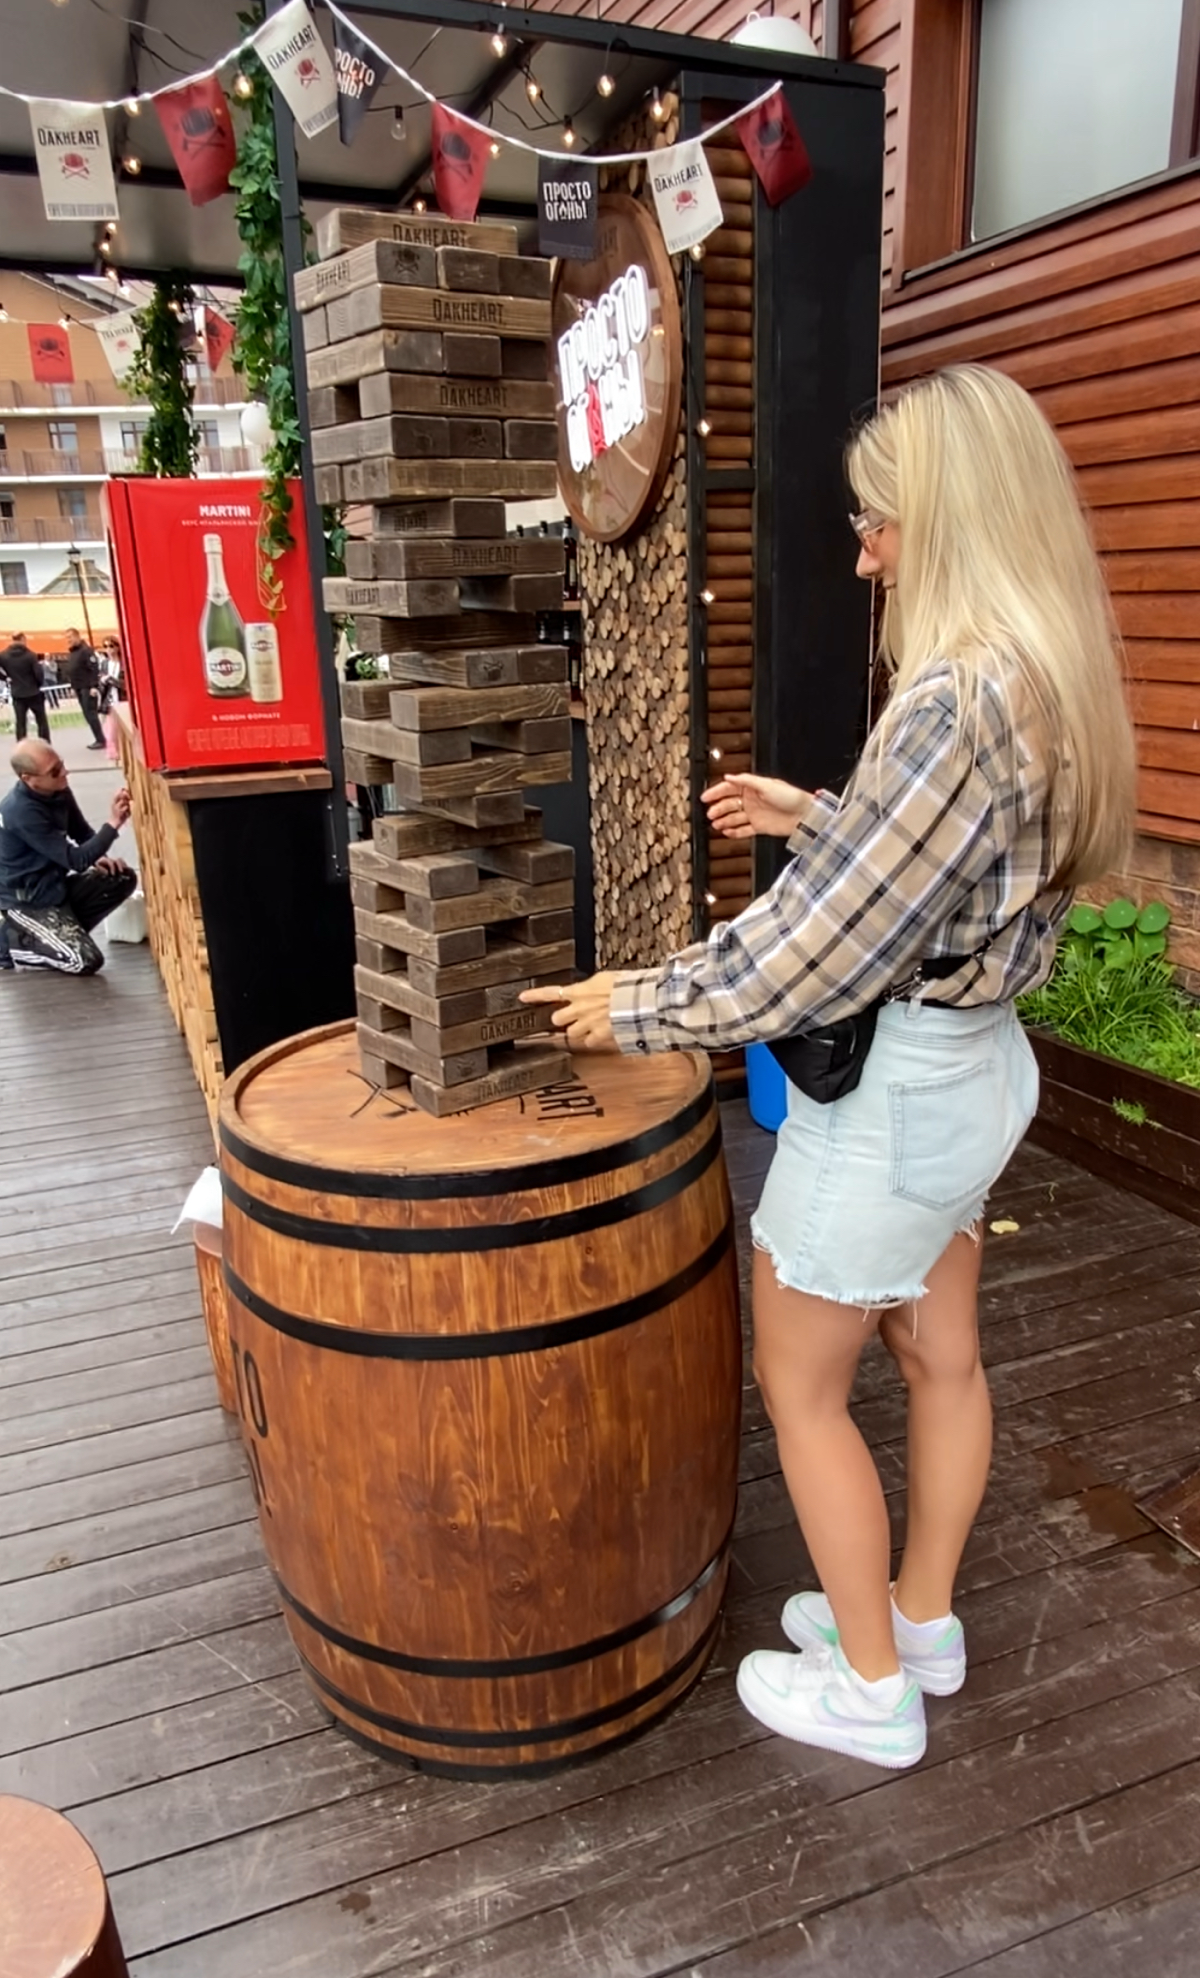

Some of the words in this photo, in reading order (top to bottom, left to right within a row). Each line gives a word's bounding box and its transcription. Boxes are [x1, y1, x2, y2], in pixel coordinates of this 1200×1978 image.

[267, 24, 317, 70] OAKHEART
[335, 48, 375, 86] РОСТО
[37, 127, 101, 147] OAKHEART
[543, 181, 592, 202] ПРОСТО
[653, 163, 704, 194] OAKHEART
[433, 298, 505, 324] OAKHEART
[558, 264, 650, 407] ПРОСТО
[440, 385, 508, 408] OAKHEART
[199, 504, 251, 517] MARTINI
[480, 1012, 537, 1042] OAKHEART
